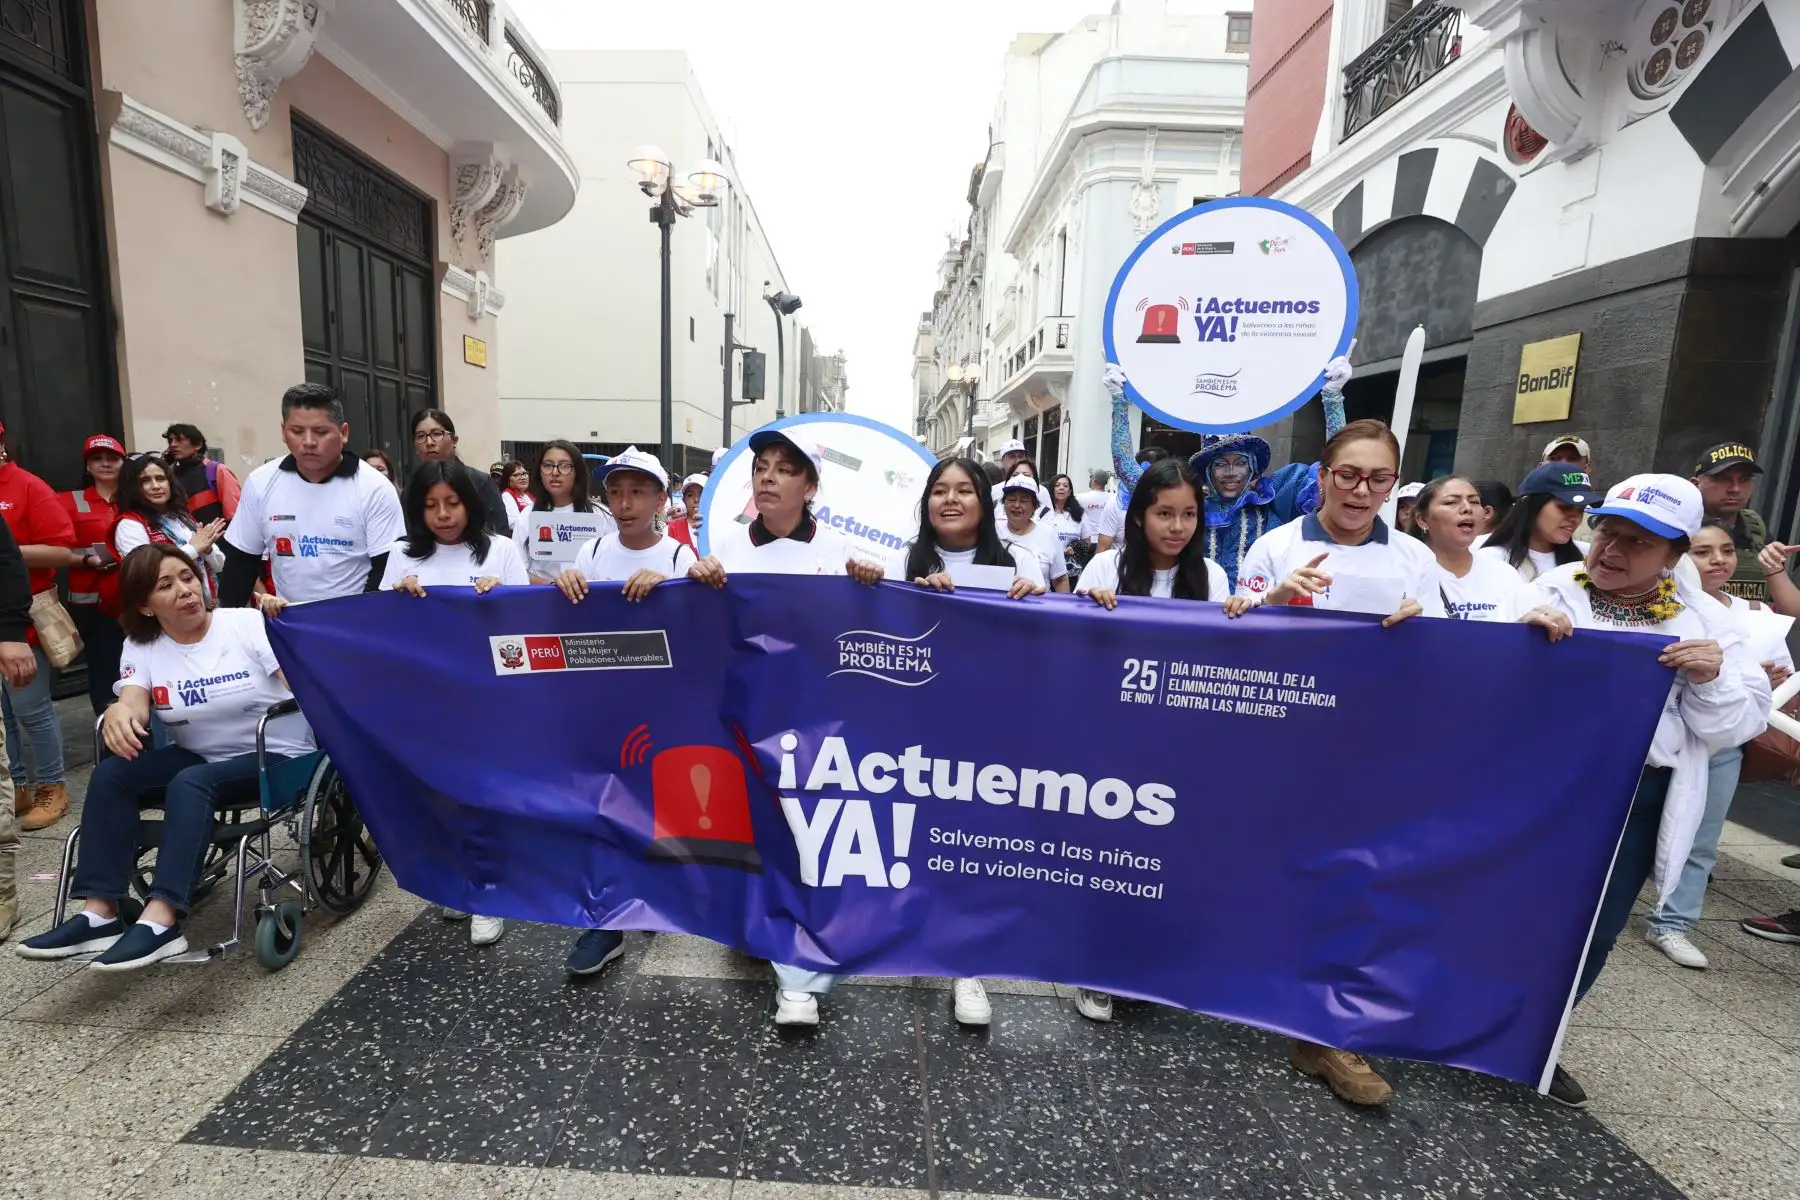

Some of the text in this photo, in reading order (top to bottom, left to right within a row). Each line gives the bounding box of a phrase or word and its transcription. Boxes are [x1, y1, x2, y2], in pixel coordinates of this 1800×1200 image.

[1195, 297, 1321, 314] ¡Actuemos
[1194, 316, 1239, 342] YA!
[1196, 377, 1222, 385] TAMBIÉN
[1518, 366, 1574, 394] BanBif
[556, 532, 572, 542] YA!
[531, 645, 560, 658] PERÚ
[567, 647, 578, 655] de
[580, 647, 587, 655] la
[588, 647, 611, 656] Mujer
[569, 654, 664, 664] Poblaciones Vulnerables
[838, 640, 931, 658] TAMBIÉN ES MI
[839, 652, 932, 673] PROBLEMA
[177, 670, 250, 690] ¡Actuemos
[1121, 658, 1159, 691] 25
[1170, 661, 1316, 689] DÍA INTERNACIONAL DE LA
[178, 688, 208, 707] YA!
[1120, 691, 1155, 705] DE NOV
[1168, 678, 1337, 708] ELIMINACIÓN DE LA VIOLENCIA
[1166, 694, 1287, 718] CONTRA LAS MUJERES
[778, 733, 1177, 826] ¡Actuemos
[779, 797, 917, 890] YA!
[929, 827, 1162, 872] Salvemos a las niñas
[928, 855, 1163, 899] de la violencia sexual
